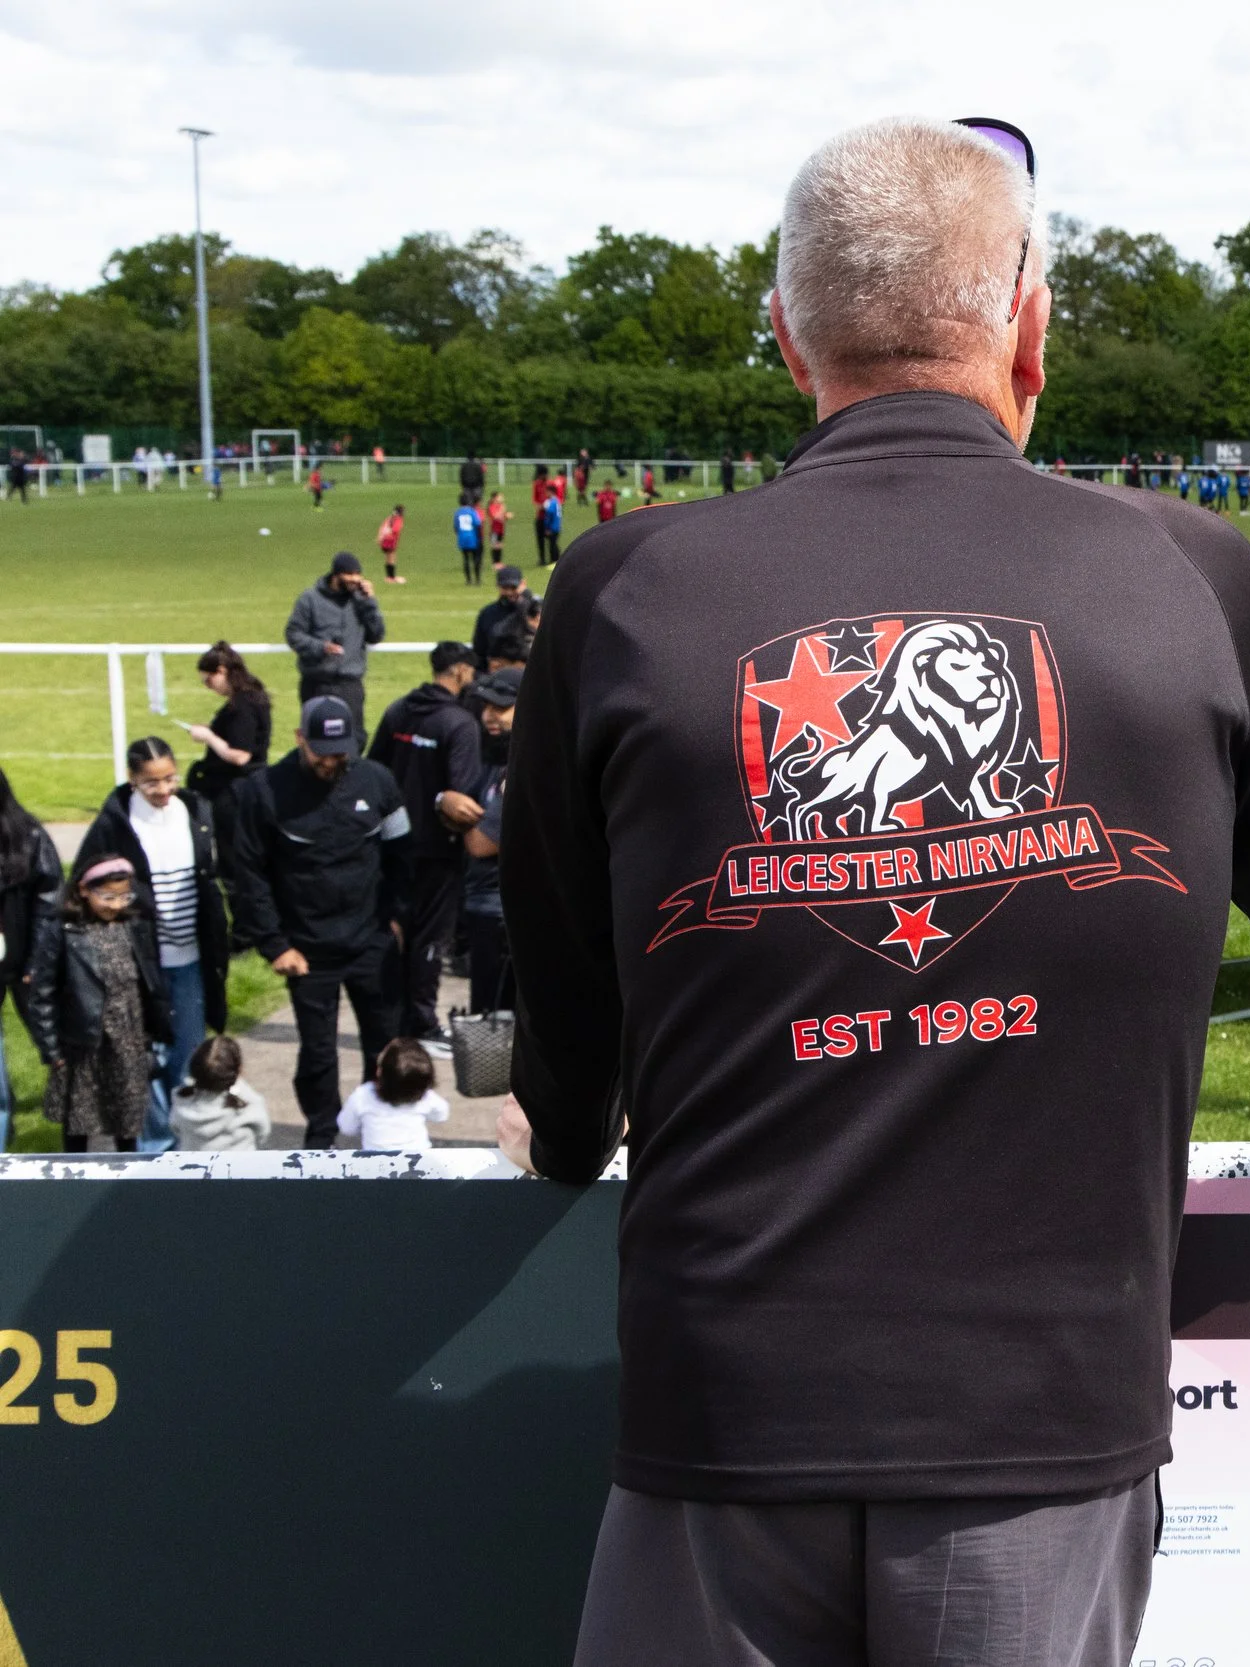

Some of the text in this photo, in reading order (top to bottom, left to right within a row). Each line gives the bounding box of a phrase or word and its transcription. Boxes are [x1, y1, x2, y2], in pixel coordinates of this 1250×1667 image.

[727, 817, 1100, 897] LEICESTER NIRVANA
[791, 994, 1038, 1061] EST 1982
[0, 1328, 118, 1426] 25
[1170, 1379, 1239, 1411] ort
[1177, 1515, 1194, 1524] 507
[1197, 1515, 1219, 1523] 7922
